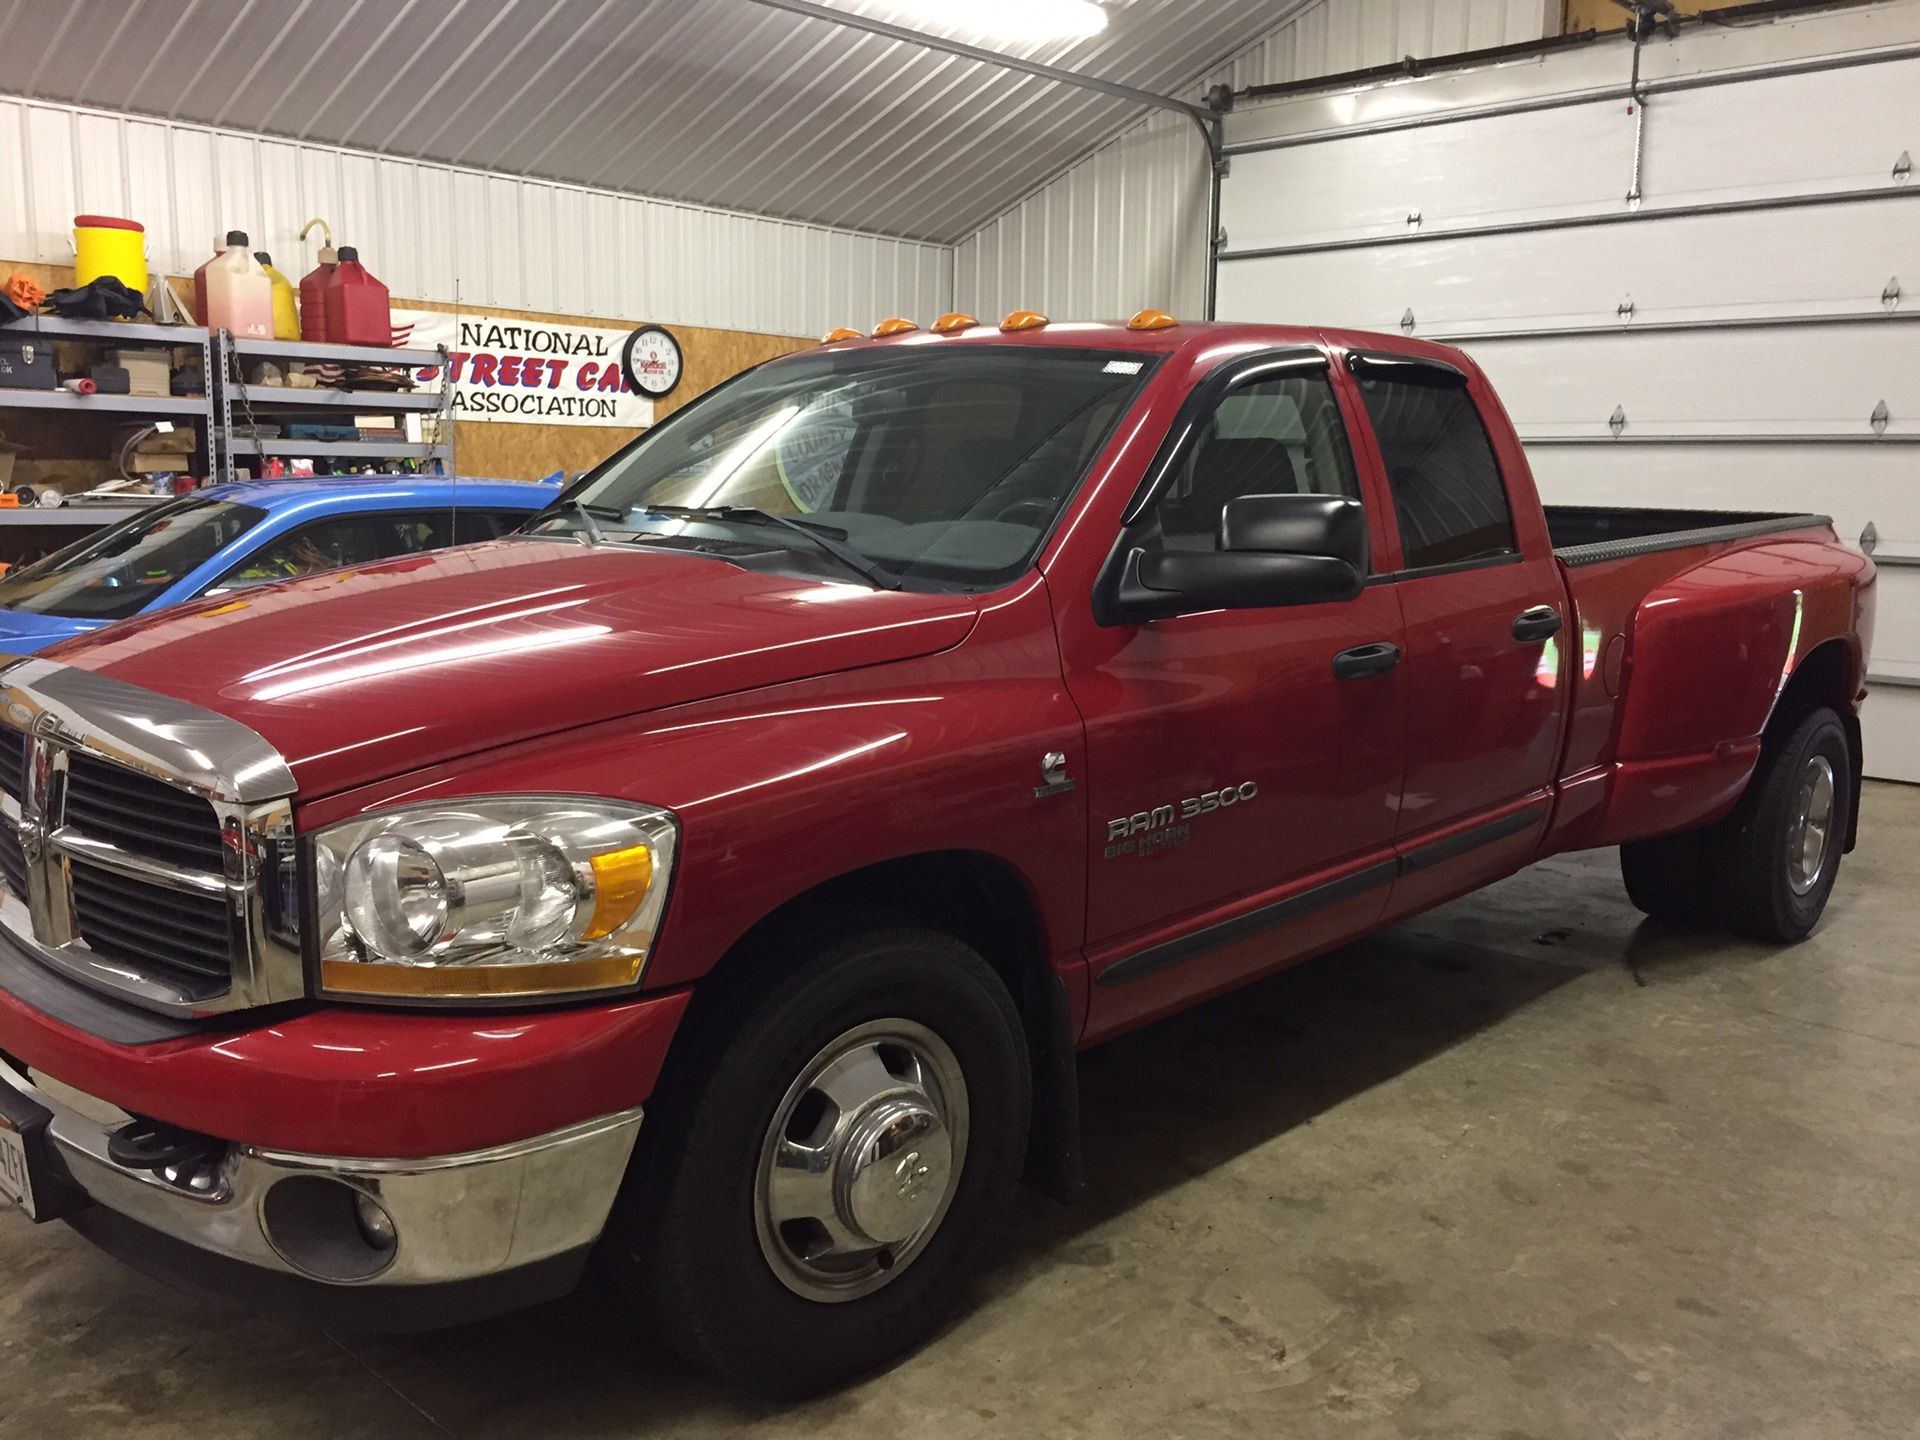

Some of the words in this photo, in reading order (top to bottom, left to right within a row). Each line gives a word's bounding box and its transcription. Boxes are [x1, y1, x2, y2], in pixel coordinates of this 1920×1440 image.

[460, 322, 609, 357] NATIONAL
[451, 390, 617, 418] ASSOCIATION
[1107, 804, 1176, 842] RAM
[1180, 780, 1259, 820] 3500
[1138, 823, 1191, 851] HORN
